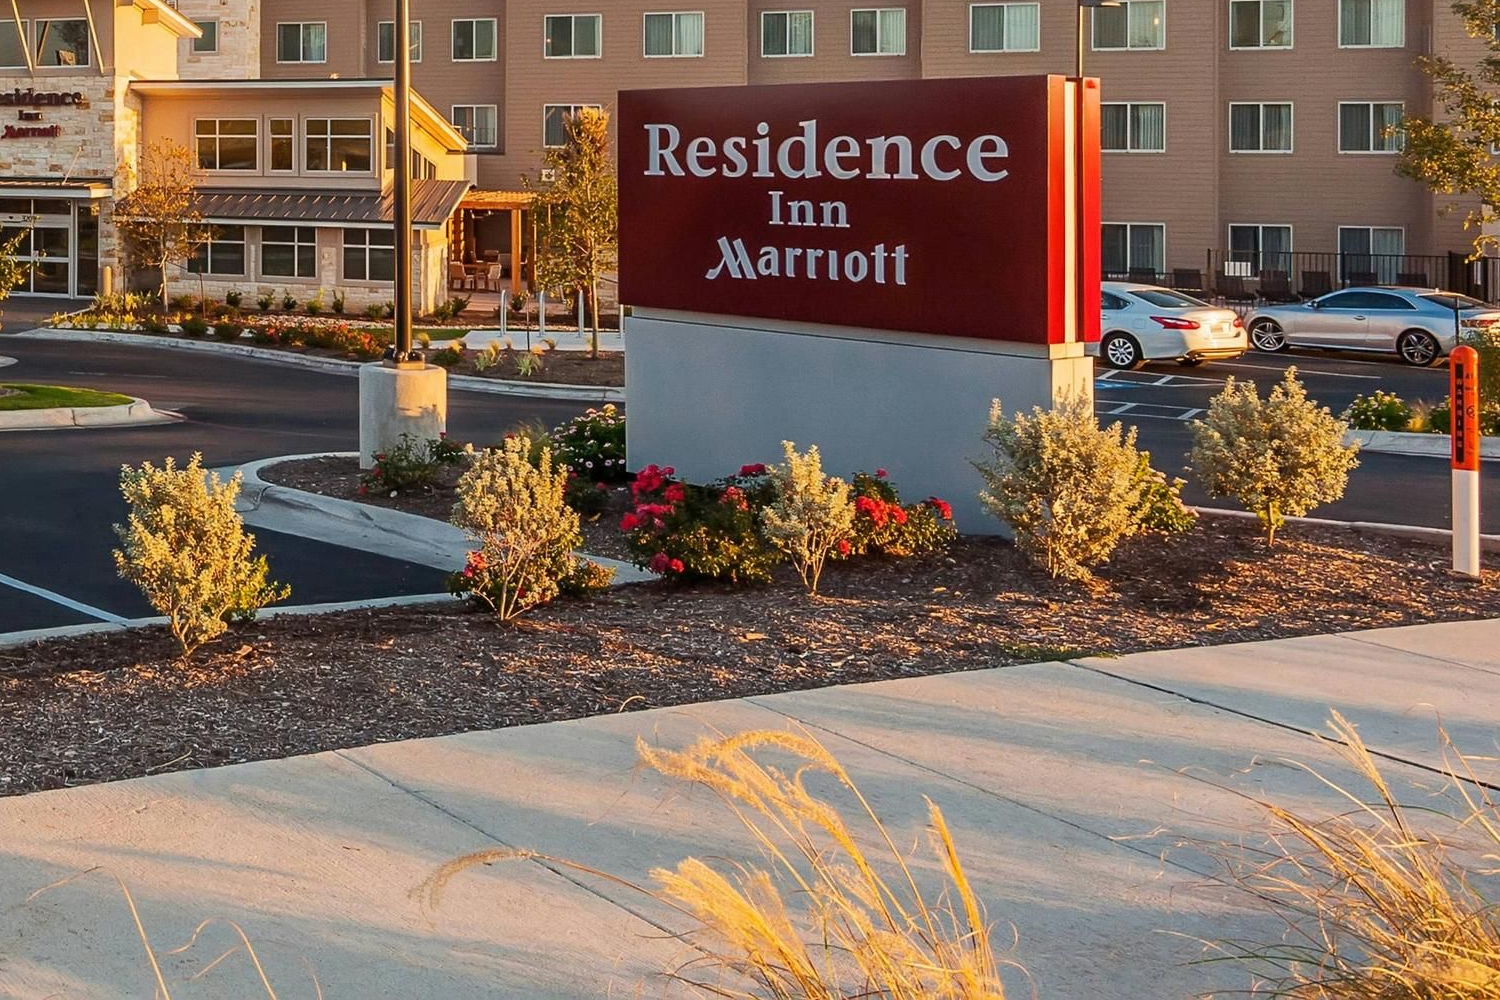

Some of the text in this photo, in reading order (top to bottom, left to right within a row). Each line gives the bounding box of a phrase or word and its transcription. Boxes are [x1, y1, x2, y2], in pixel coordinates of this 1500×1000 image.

[643, 119, 1010, 183] Residence
[768, 190, 850, 228] Inn
[704, 236, 909, 286] Marriott
